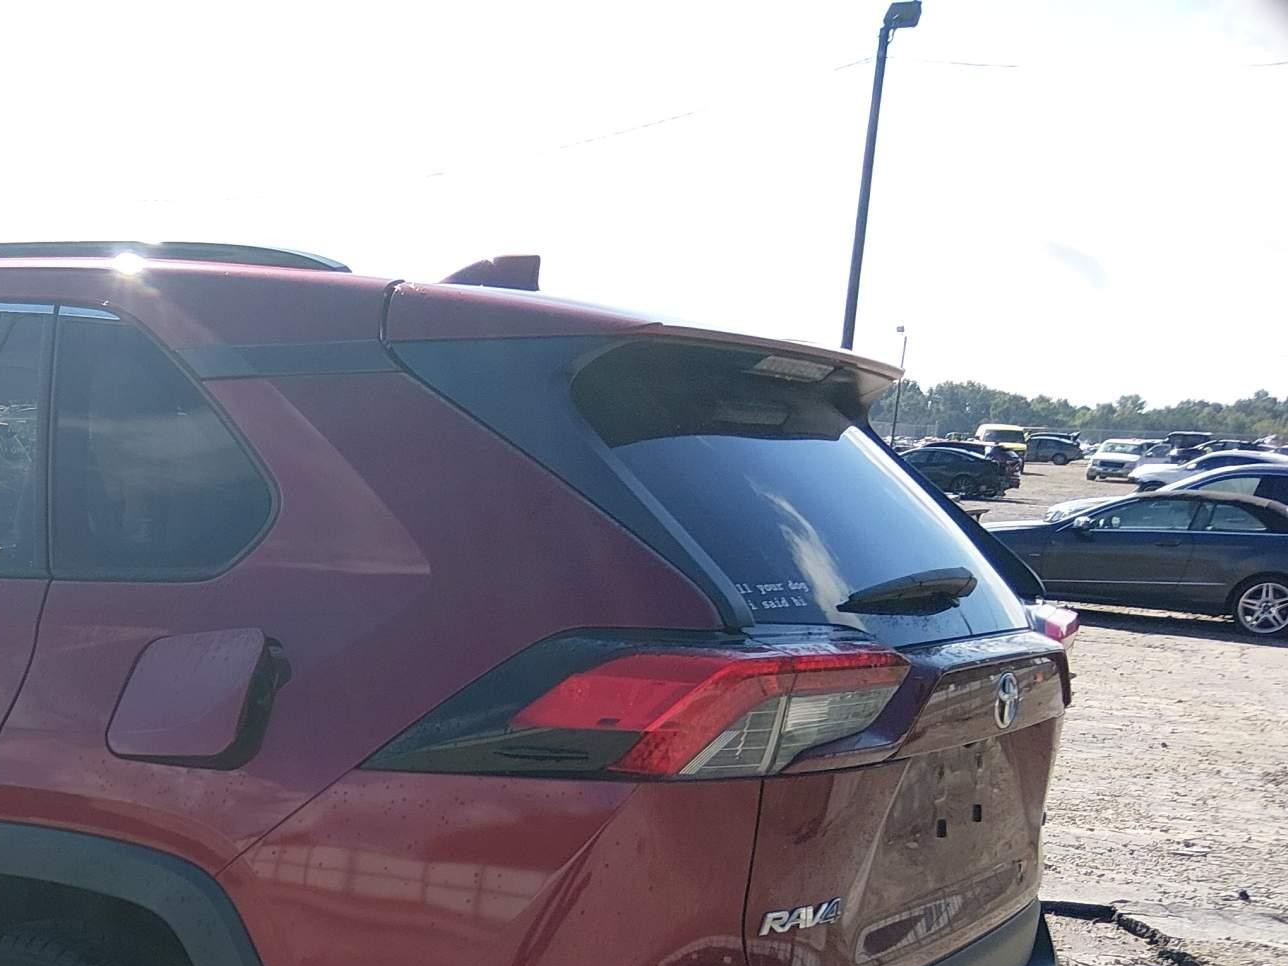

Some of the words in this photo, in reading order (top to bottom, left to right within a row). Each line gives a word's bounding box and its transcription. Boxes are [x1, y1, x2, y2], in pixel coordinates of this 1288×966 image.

[756, 583, 784, 595] your
[788, 580, 809, 593] dog
[761, 597, 790, 609] said
[791, 595, 808, 607] hi
[759, 898, 841, 936] RAV4
